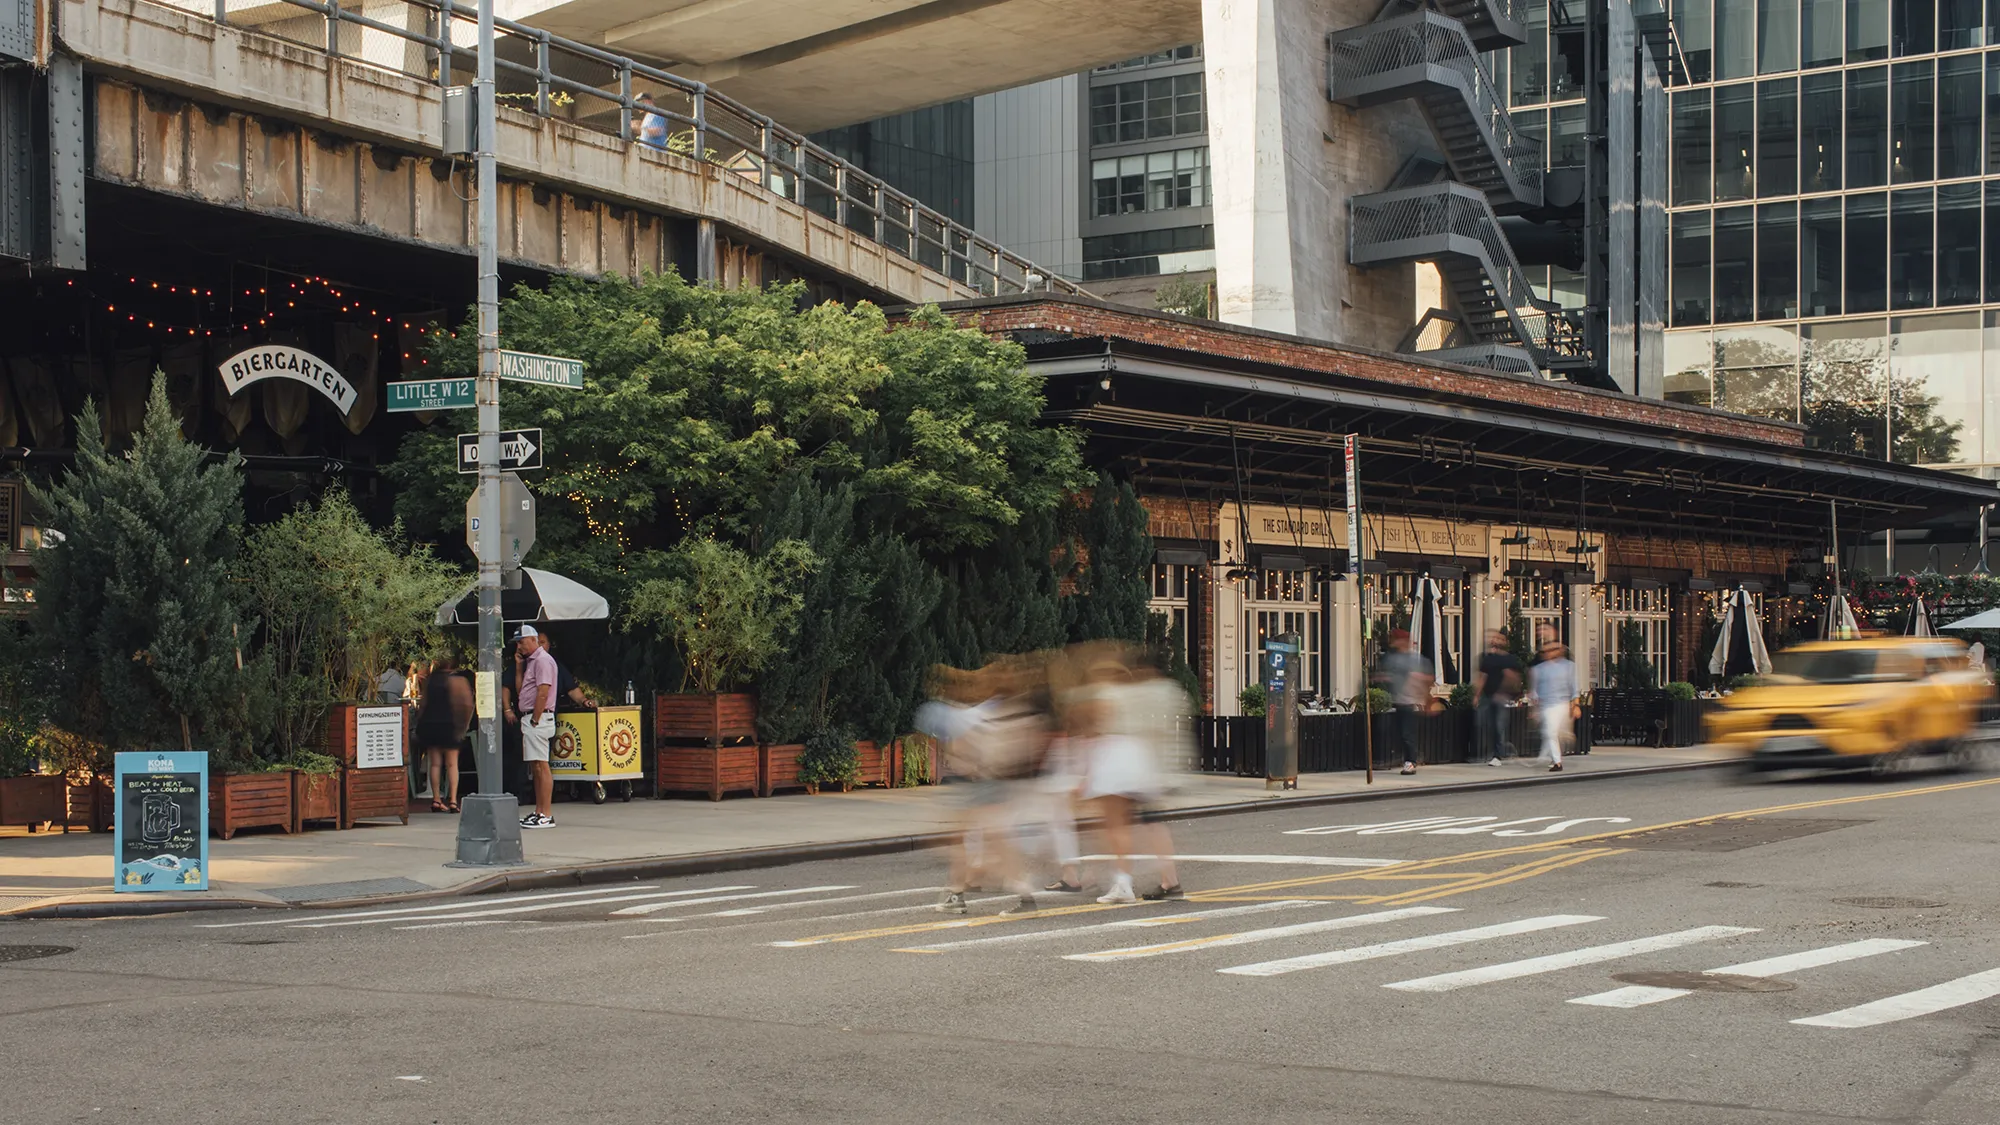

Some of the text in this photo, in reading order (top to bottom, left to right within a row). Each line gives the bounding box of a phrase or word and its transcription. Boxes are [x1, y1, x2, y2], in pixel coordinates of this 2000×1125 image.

[231, 352, 346, 401] BIERGARTEN
[502, 354, 580, 383] WASHINGTON ST
[396, 381, 469, 400] LITTLE W 12
[420, 398, 446, 408] STREET
[504, 442, 529, 458] WAY
[1263, 518, 1328, 537] THE STANDARD GRILL
[1383, 528, 1400, 542] FISH
[1405, 529, 1428, 544] FOWL
[1455, 533, 1477, 547] PORK
[555, 720, 582, 757] OT PRETZELS
[603, 718, 638, 740] SOFT PRETZELS
[603, 747, 638, 769] HOT AND FRESH
